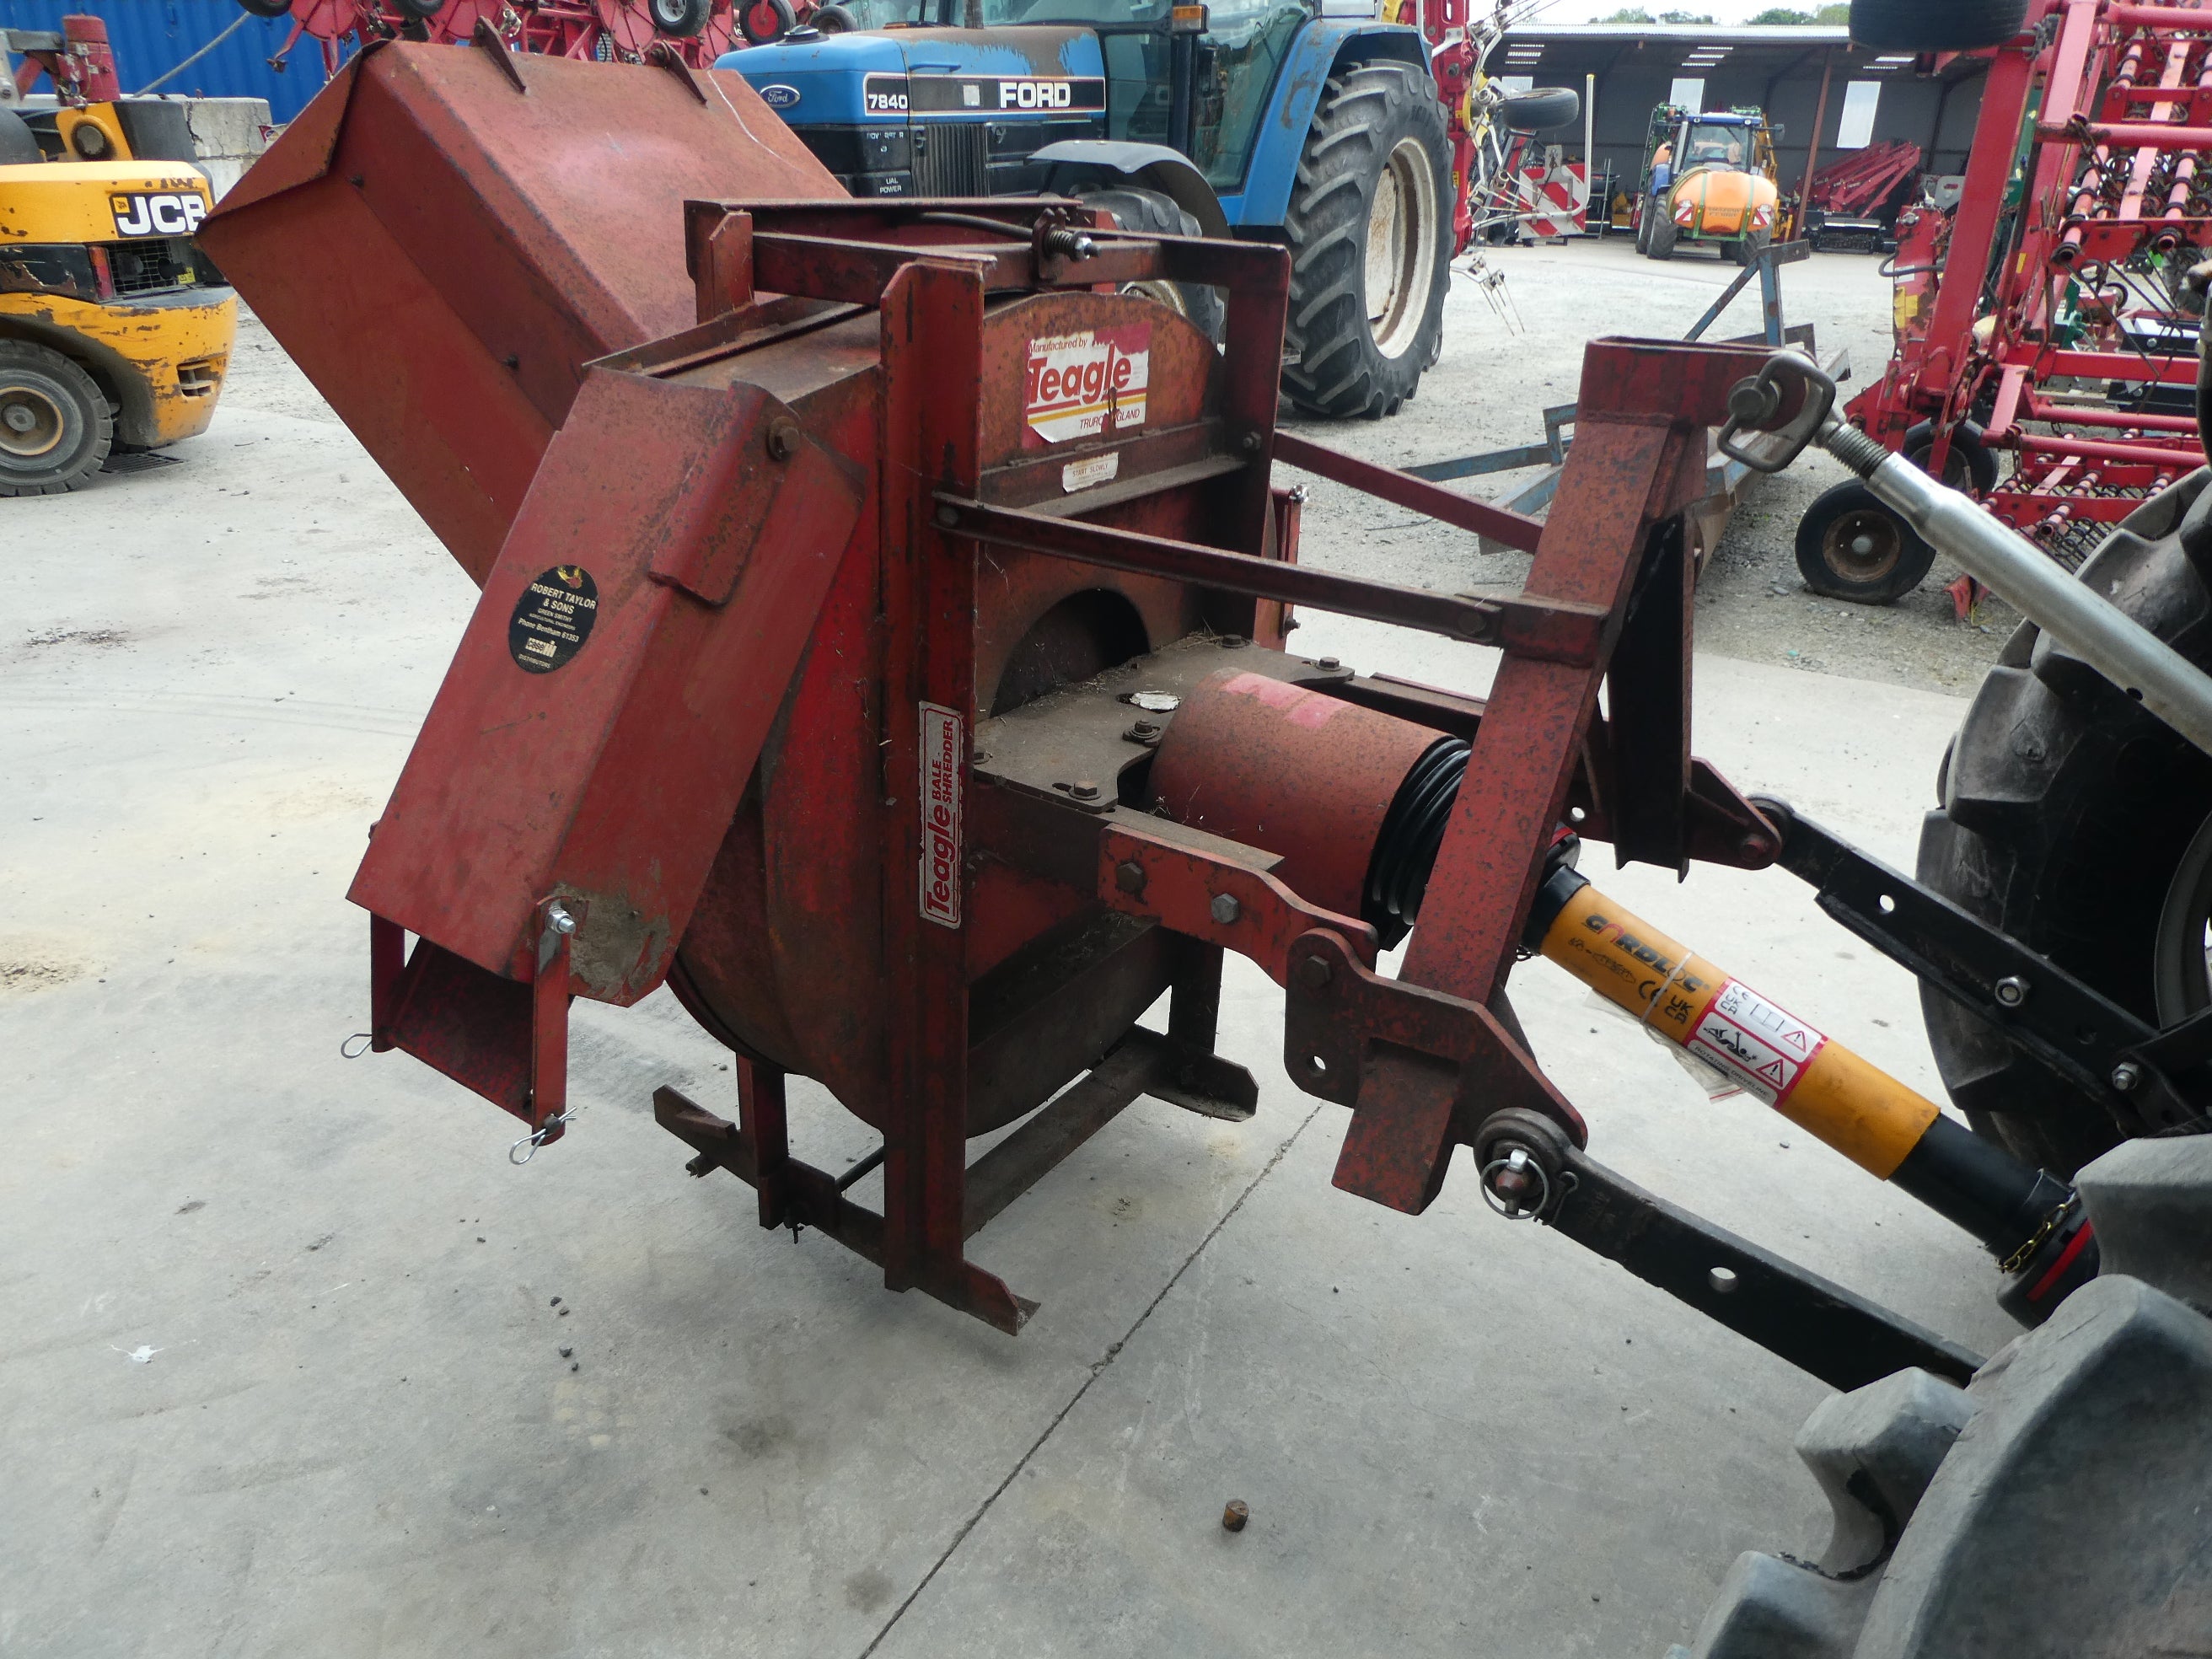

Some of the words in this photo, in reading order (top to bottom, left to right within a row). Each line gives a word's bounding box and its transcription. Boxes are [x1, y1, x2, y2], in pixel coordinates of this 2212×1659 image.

[767, 90, 789, 103] Ford
[867, 94, 908, 110] 7840
[1000, 82, 1071, 109] FORD
[879, 185, 902, 194] POWER
[117, 195, 207, 234] JCB
[1028, 338, 1077, 354] Manufactured
[1078, 336, 1088, 350] by
[1028, 343, 1131, 405] Teagle
[1072, 468, 1087, 477] START
[1089, 462, 1109, 473] SLOWLY
[531, 583, 565, 599] ROBERT
[565, 592, 597, 609] TAYLOR
[538, 608, 555, 618] GREEN
[554, 613, 573, 623] SMITHY
[543, 598, 550, 607] &
[550, 600, 575, 615] SONS
[518, 617, 536, 629] Phone
[535, 623, 561, 636] Bentham
[561, 631, 580, 642] 61353
[518, 653, 551, 668] DISTRIBUTORS
[942, 720, 953, 804] SHREDDER
[932, 759, 942, 801] BALE
[927, 804, 956, 915] Teagle
[1725, 994, 1742, 1007] UK
[1732, 985, 1749, 1001] CE
[1671, 995, 1694, 1016] UK
[1720, 1002, 1737, 1015] CA
[1664, 1006, 1689, 1025] CA
[1694, 1045, 1731, 1071] ROTATING
[1731, 1070, 1769, 1097] DRIVELINE
